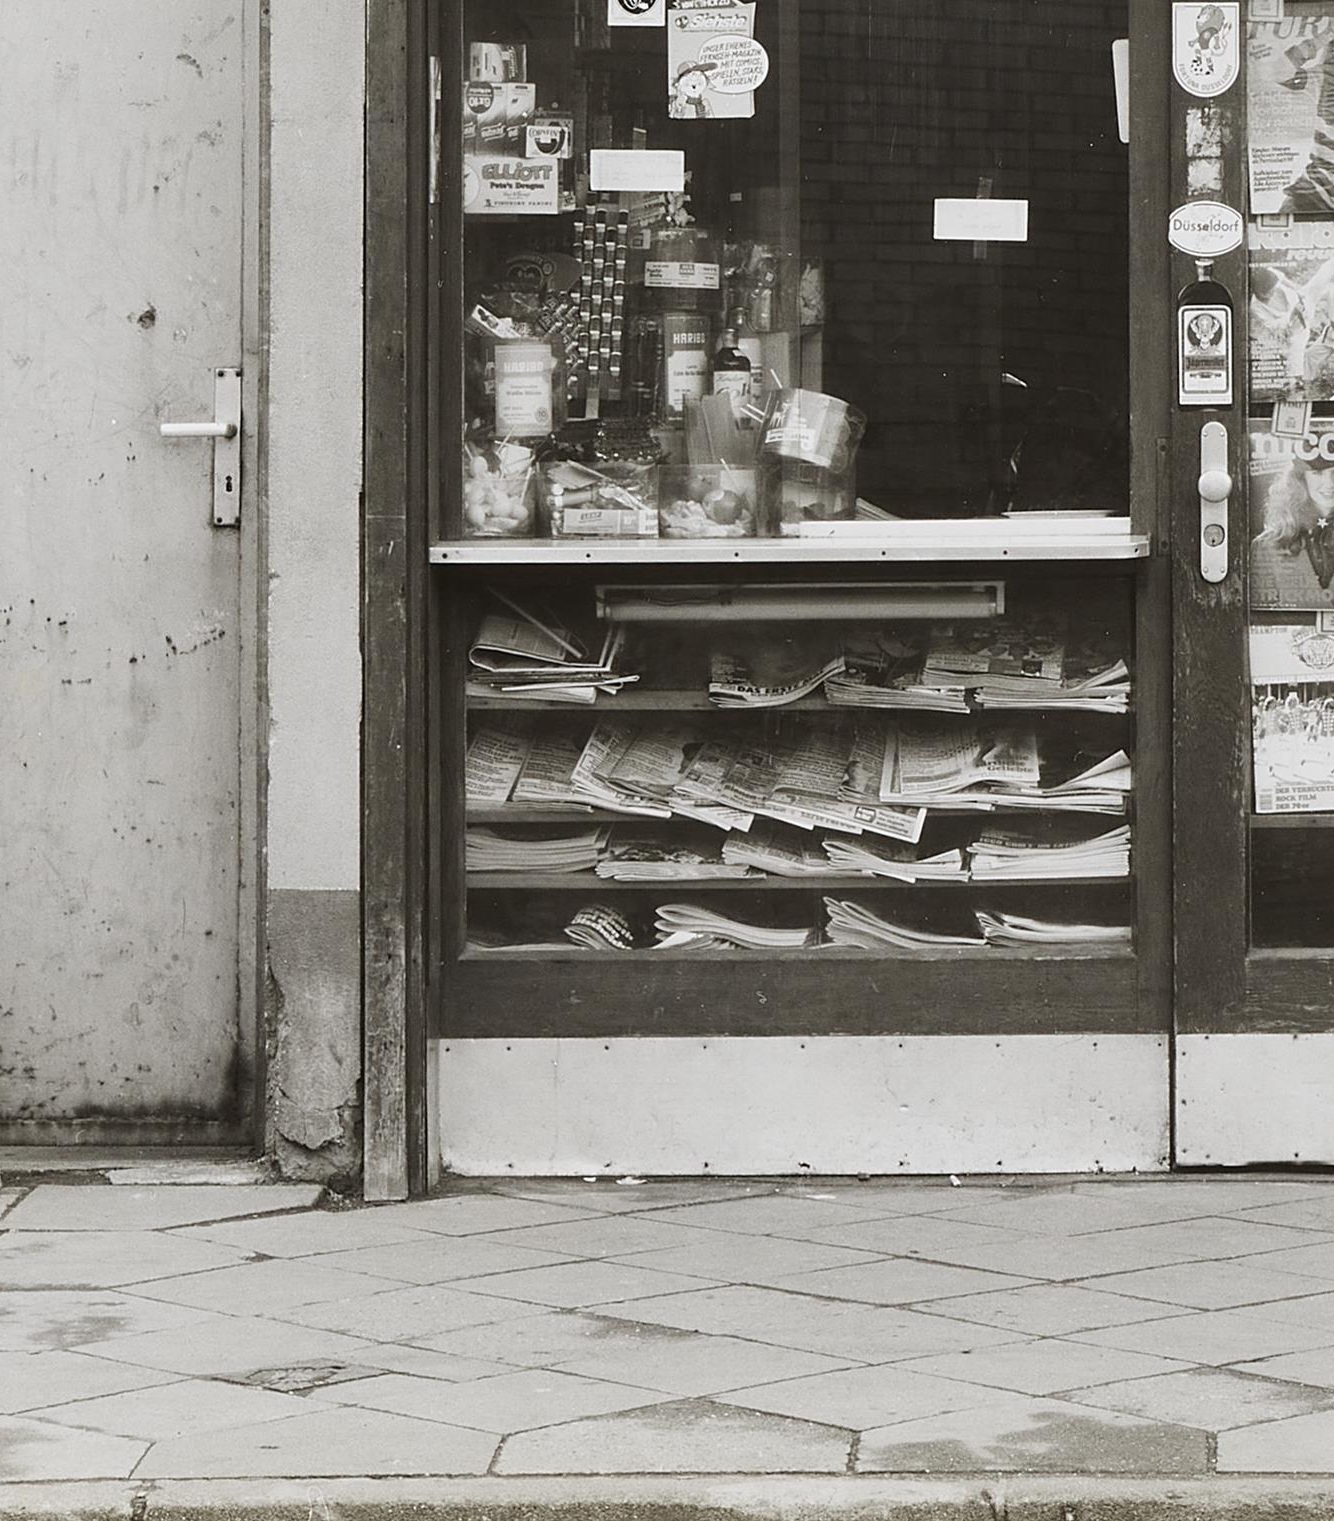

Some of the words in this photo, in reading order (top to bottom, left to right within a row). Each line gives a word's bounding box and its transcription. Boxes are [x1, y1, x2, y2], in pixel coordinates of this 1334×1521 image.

[490, 181, 513, 189] Pete's
[515, 182, 545, 190] Dragon
[1173, 218, 1240, 232] Düsseldorf
[673, 333, 705, 344] HARIBO
[737, 685, 761, 694] DAS
